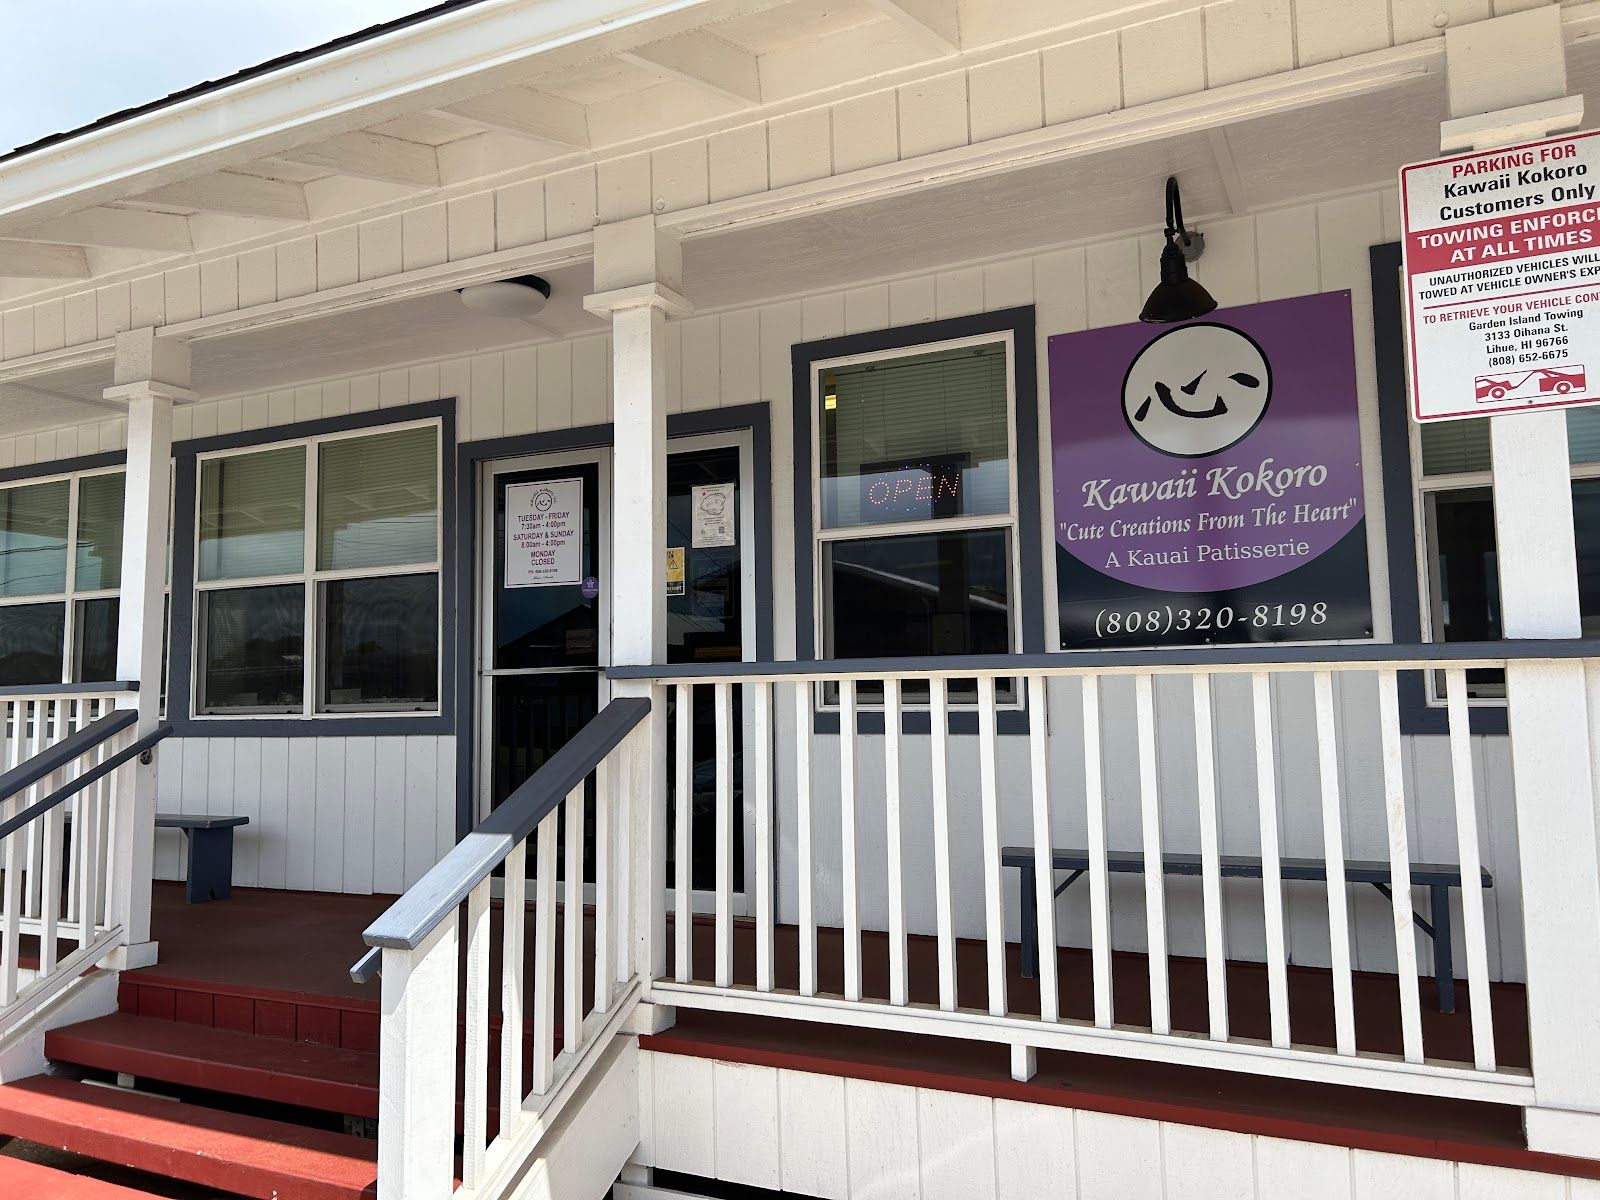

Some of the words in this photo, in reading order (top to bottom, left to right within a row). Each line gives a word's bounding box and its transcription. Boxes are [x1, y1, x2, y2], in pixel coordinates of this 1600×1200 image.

[1452, 152, 1534, 179] PARKING
[1540, 144, 1577, 163] FOR
[1444, 174, 1511, 198] Kawaii
[1517, 164, 1588, 186] Kokoro
[1440, 194, 1545, 221] Customers
[1551, 184, 1596, 202] Only
[1417, 223, 1503, 249] TOWING
[1450, 247, 1477, 264] AT
[1481, 241, 1520, 259] ALL
[1523, 228, 1593, 252] TIMES
[1419, 287, 1458, 301] TOWED
[1460, 285, 1475, 297] AT
[1476, 278, 1522, 293] VEHICLE
[1524, 269, 1577, 286] OWNER'S
[1429, 266, 1514, 287] UNAUTHORIZED
[1516, 257, 1570, 274] VEHICLES
[1571, 252, 1600, 265] WILL
[1423, 314, 1437, 325] TO
[1439, 307, 1490, 323] RETRIEVE
[1492, 302, 1524, 316] YOUR
[1526, 295, 1572, 312] VEHICLE
[1469, 319, 1506, 331] Garden
[1509, 313, 1541, 326] Island
[1544, 308, 1584, 322] Towing
[1484, 331, 1511, 342] 3133
[1513, 325, 1551, 339] Oihana
[1553, 322, 1569, 334] St.
[1486, 342, 1518, 355] Lihue,
[1521, 340, 1533, 351] HI
[1535, 335, 1570, 348] 96766
[1488, 355, 1516, 369] (808)
[1518, 348, 1569, 364] 652-6675
[869, 472, 960, 505] OPEN
[1081, 469, 1198, 511] Kawaii
[1205, 457, 1328, 500] Kokoro
[518, 514, 545, 523] TUESDAY
[548, 511, 570, 520] FRIDAY
[1060, 520, 1105, 542] "Cute
[1110, 514, 1192, 538] Creations
[1197, 509, 1245, 532] From
[1251, 503, 1287, 528] The
[1292, 497, 1358, 524] Heart"
[513, 531, 544, 541] SATURDAY
[544, 531, 549, 539] &
[550, 529, 574, 538] SUNDAY
[530, 550, 556, 558] MONDAY
[530, 558, 555, 566] CLOSED
[1104, 551, 1121, 569] A
[1127, 546, 1189, 568] Kauai
[1197, 538, 1310, 562] Patisserie
[1094, 601, 1328, 638] (808)320-8198
